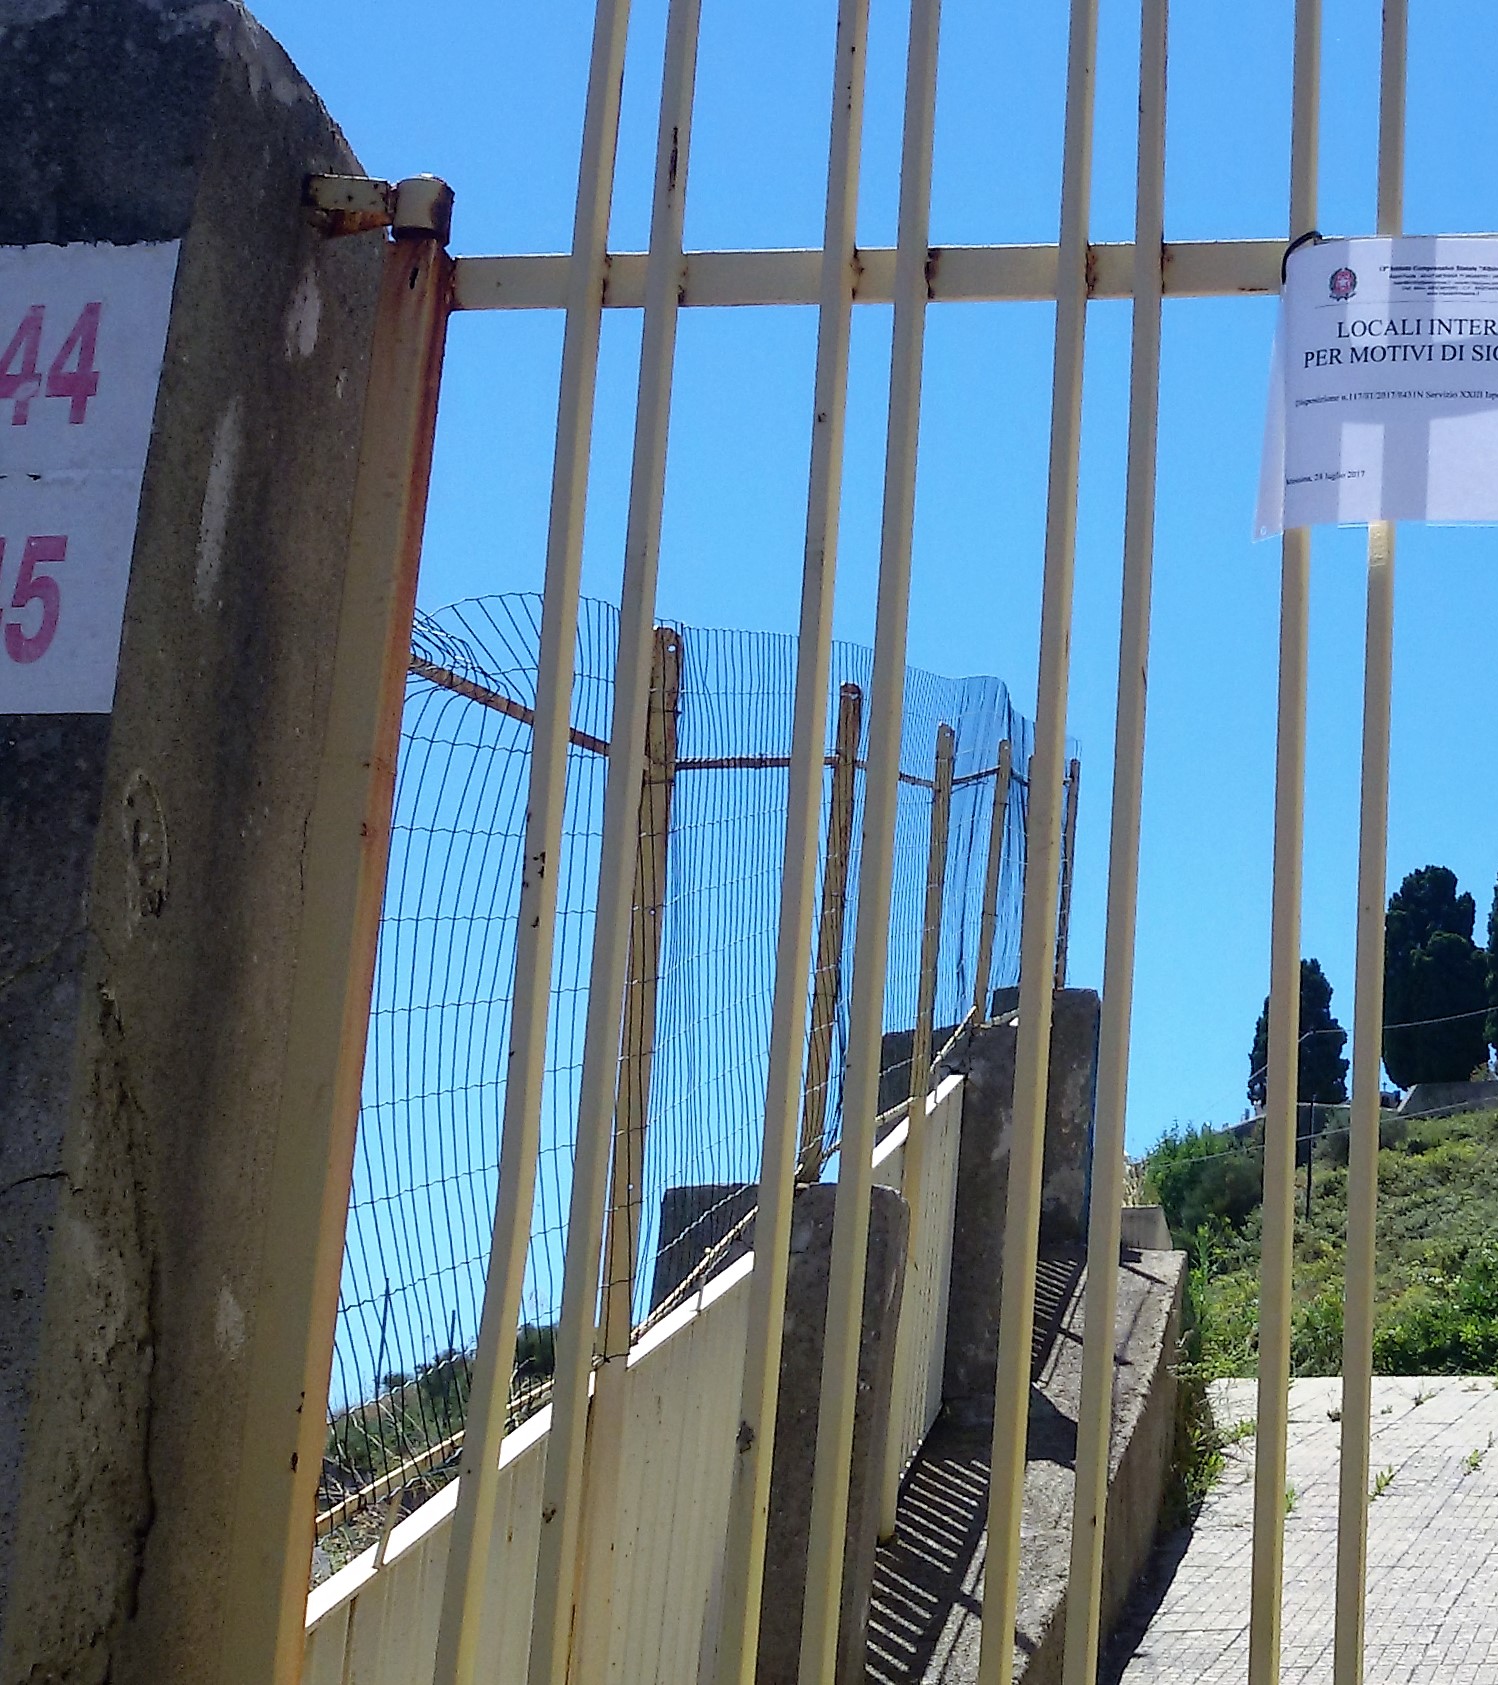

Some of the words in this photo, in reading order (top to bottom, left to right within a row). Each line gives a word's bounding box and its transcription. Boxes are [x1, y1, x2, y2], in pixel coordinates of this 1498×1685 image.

[1337, 319, 1422, 338] LOCALI
[1303, 348, 1342, 368] PER
[1350, 344, 1434, 364] MOTIVI
[1441, 344, 1465, 362] DI
[1425, 390, 1458, 399] Servizio
[1347, 470, 1366, 479] 2017
